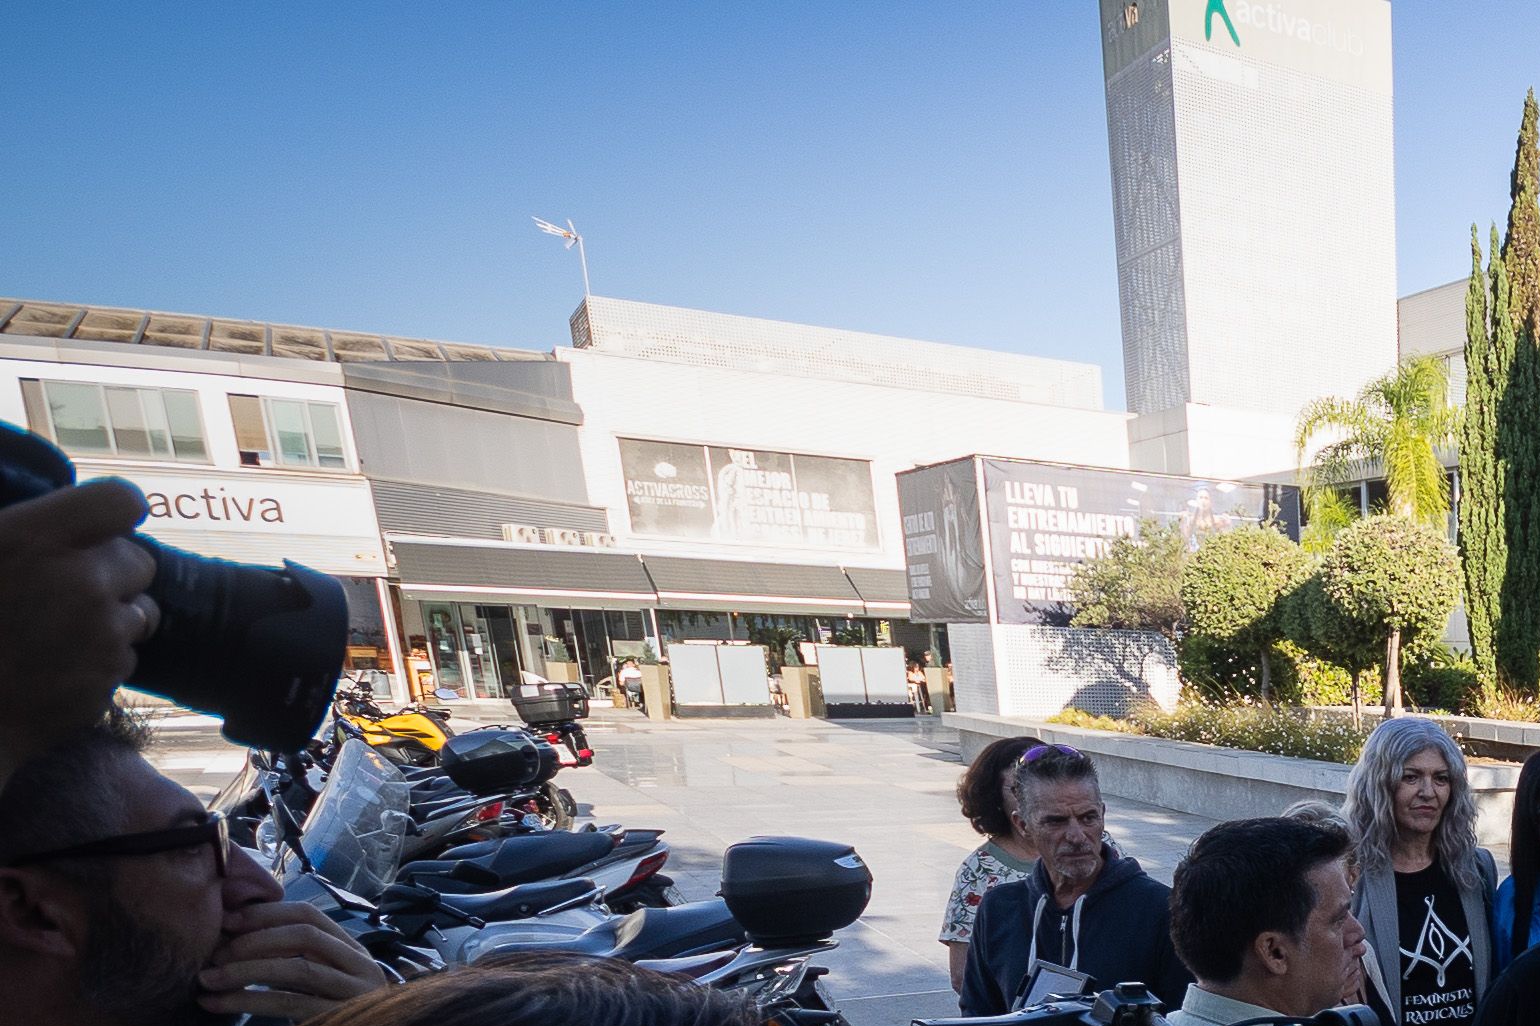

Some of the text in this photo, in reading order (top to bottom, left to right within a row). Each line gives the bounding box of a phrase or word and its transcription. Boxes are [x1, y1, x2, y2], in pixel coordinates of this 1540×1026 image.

[743, 468, 791, 490] MEJOR
[146, 487, 284, 523] activa
[1004, 480, 1078, 509] LLEVA TU
[1007, 506, 1134, 537] ENTRENAMIENTO
[1010, 531, 1031, 555] AL
[1405, 1002, 1474, 1024] RADICALES
